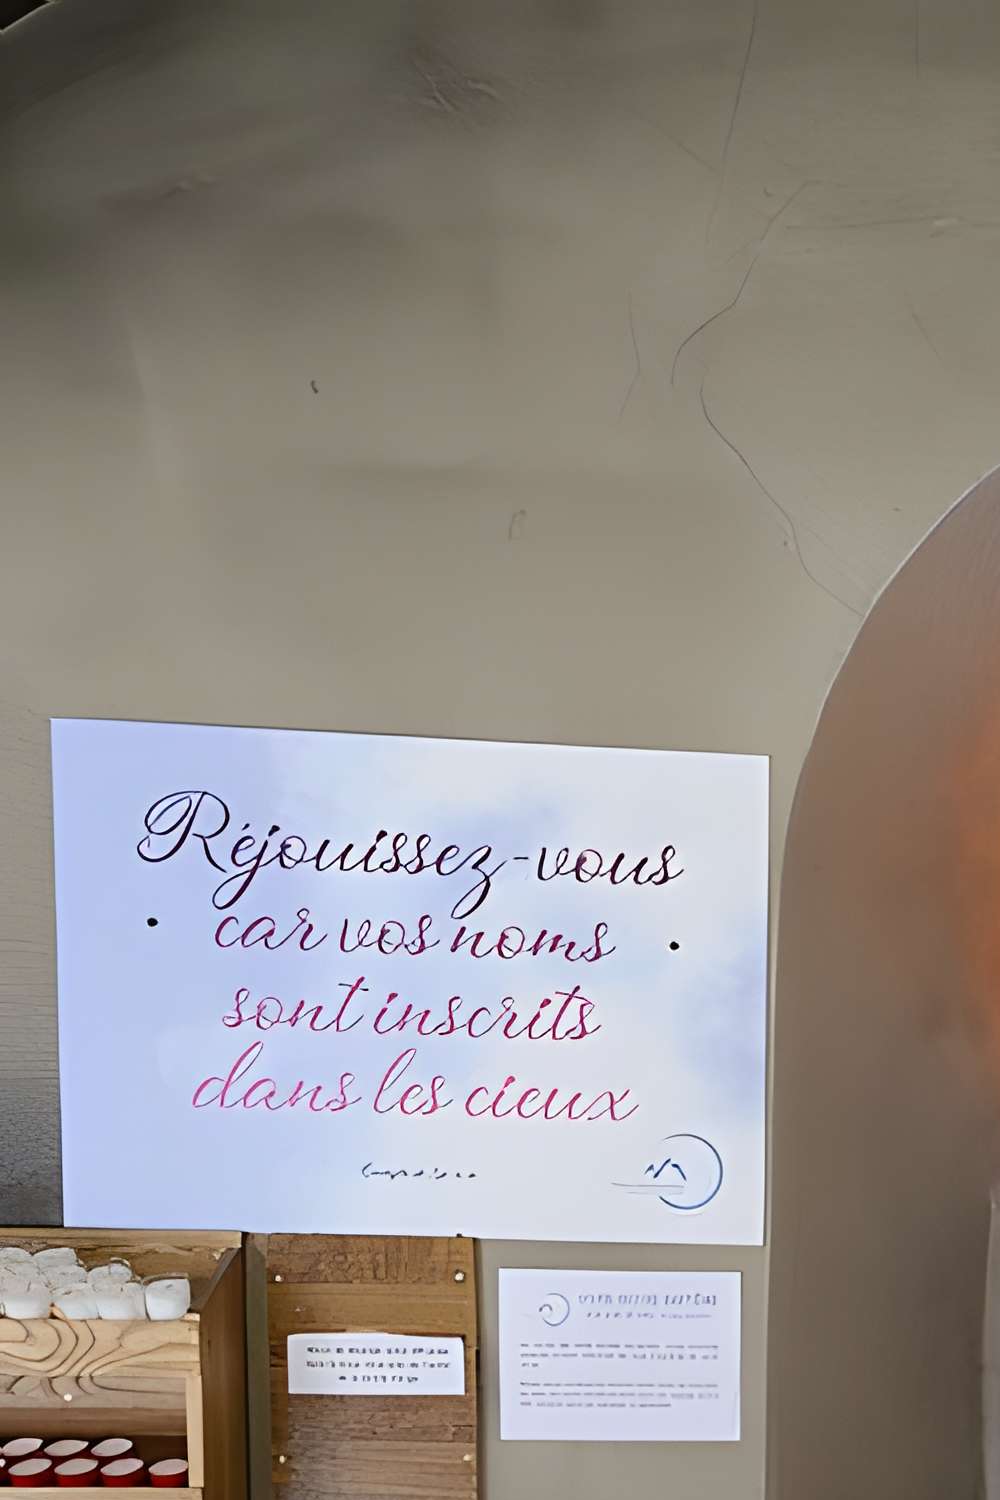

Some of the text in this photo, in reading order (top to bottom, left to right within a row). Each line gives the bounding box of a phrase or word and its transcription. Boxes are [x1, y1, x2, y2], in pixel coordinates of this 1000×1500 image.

[137, 790, 685, 920] Réjouissez-vous
[214, 908, 617, 964] car vos noms
[221, 976, 602, 1041] sont inscrits
[191, 1040, 641, 1122] dans les cieux
